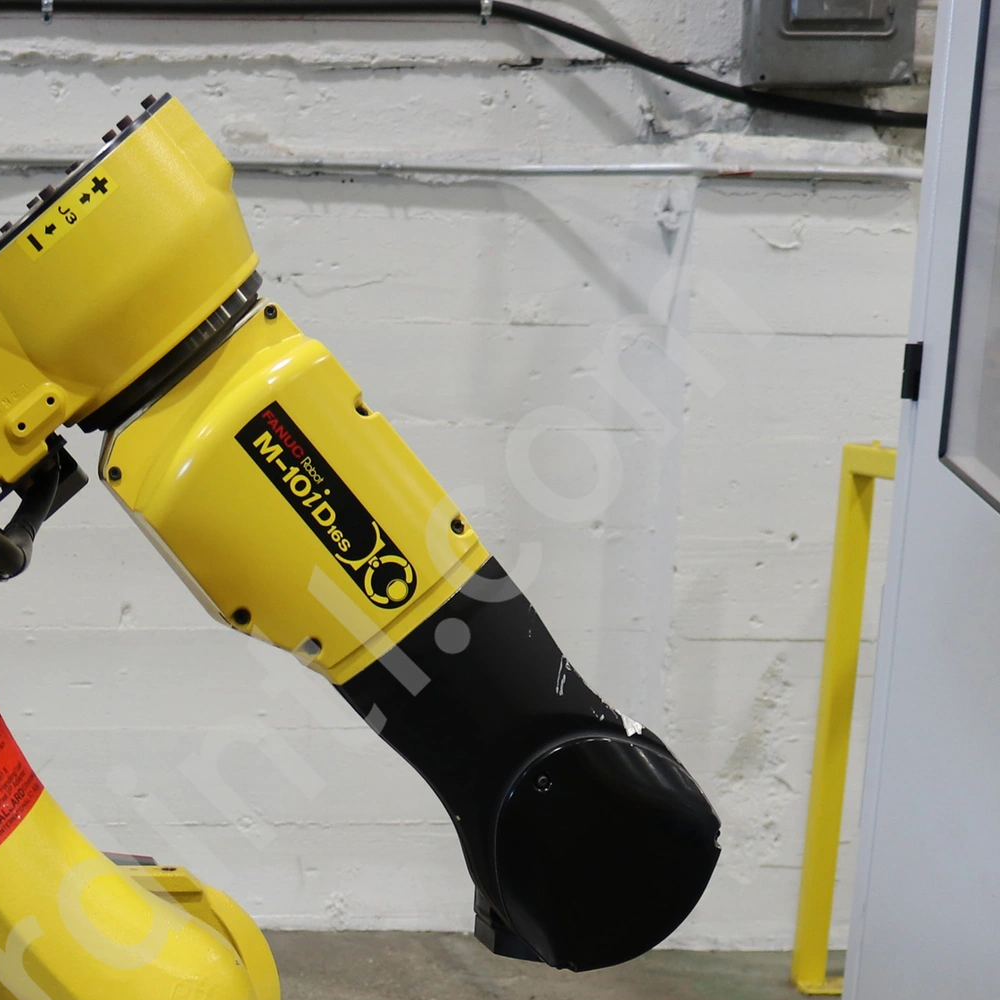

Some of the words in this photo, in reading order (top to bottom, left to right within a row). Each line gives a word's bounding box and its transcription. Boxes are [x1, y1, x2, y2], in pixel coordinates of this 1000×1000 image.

[58, 205, 77, 225] J3
[261, 409, 304, 459] FANUC
[300, 456, 324, 485] Robot
